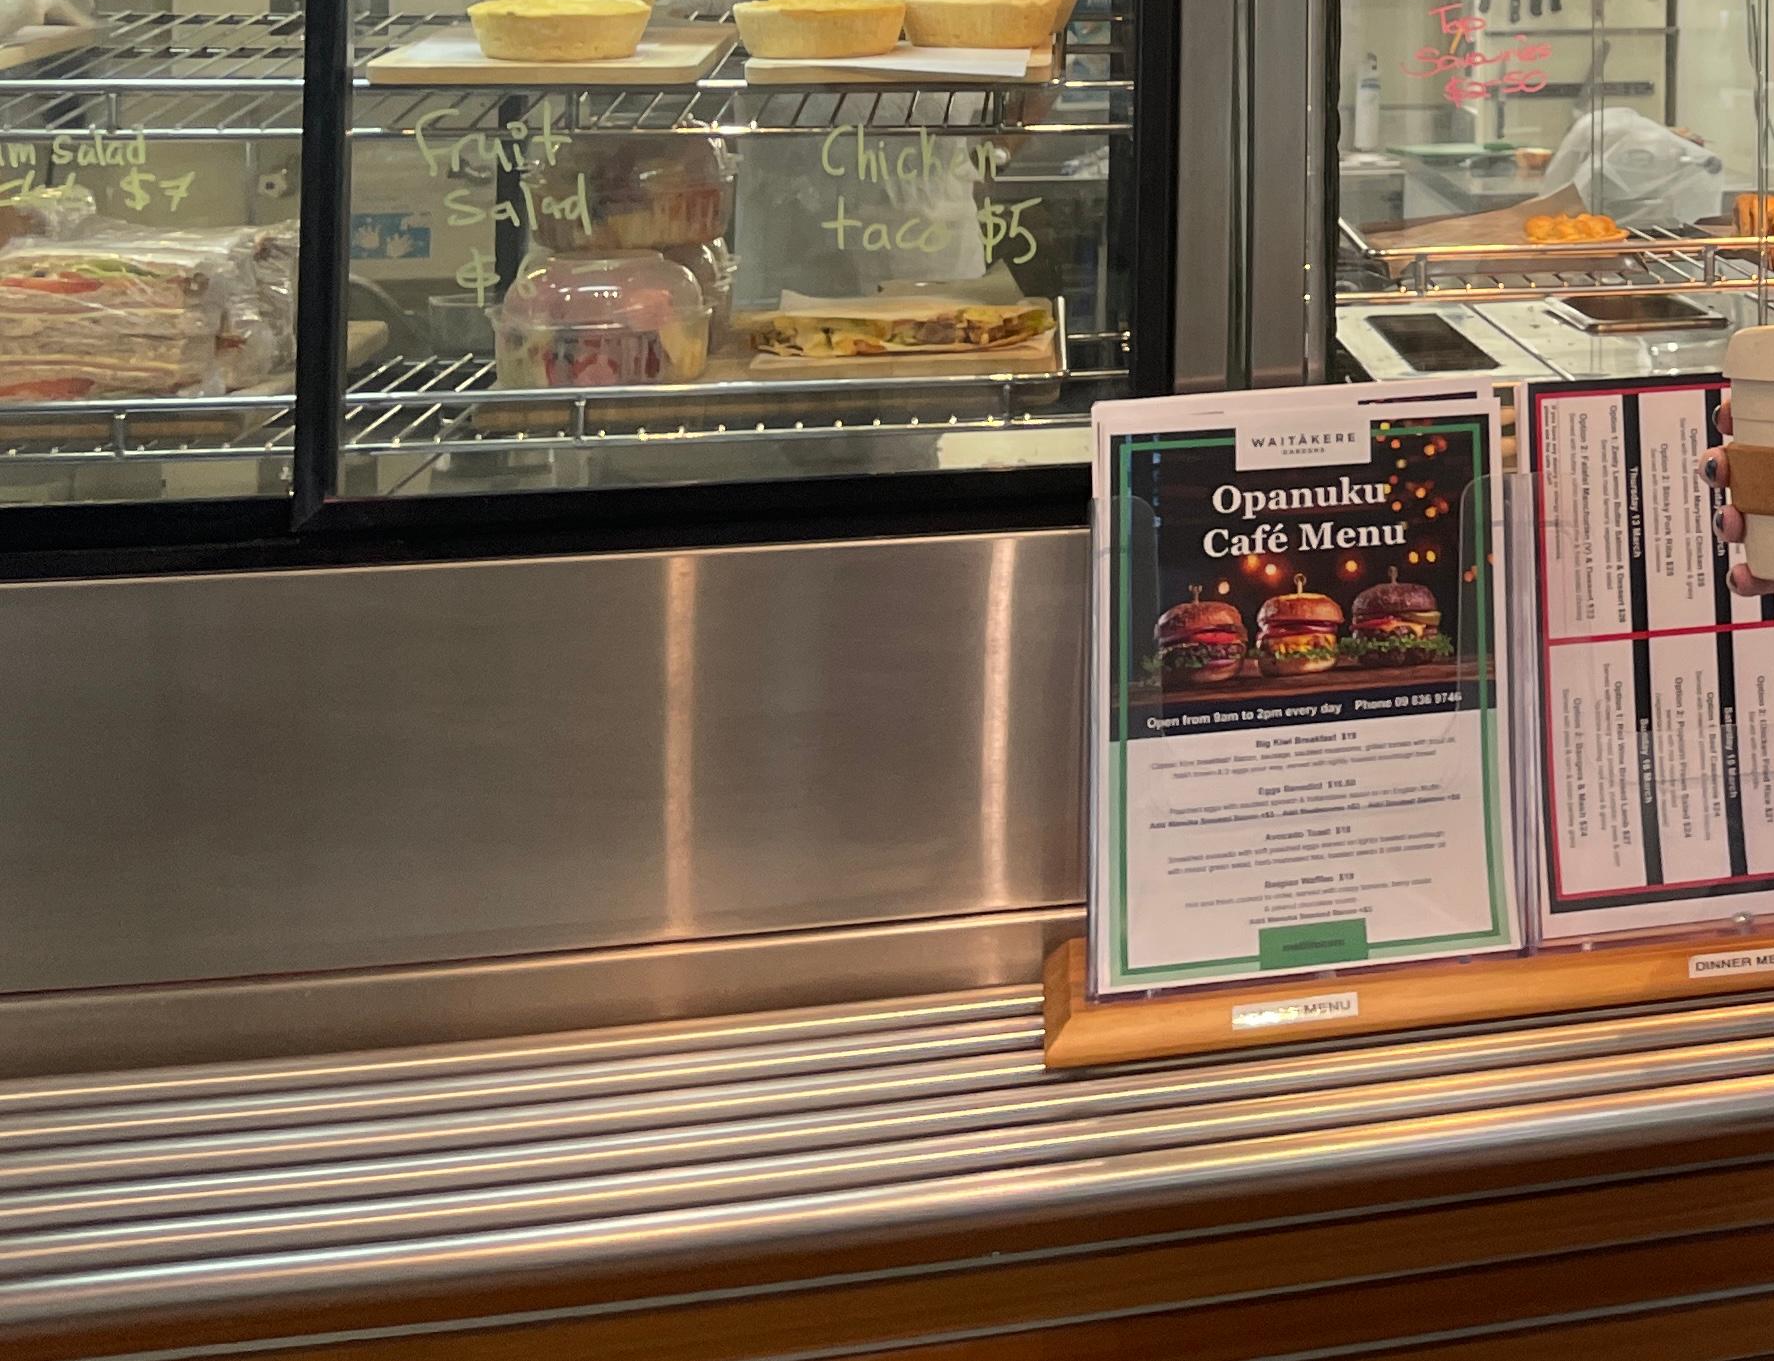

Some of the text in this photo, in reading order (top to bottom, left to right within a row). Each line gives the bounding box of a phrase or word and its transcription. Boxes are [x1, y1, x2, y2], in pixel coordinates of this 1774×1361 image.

[51, 132, 147, 167] Salad
[415, 101, 573, 177] Fruit
[822, 124, 1001, 184] Chicken
[443, 173, 593, 235] Salad
[821, 196, 1042, 265] taco $5
[1212, 476, 1388, 519] Opanuku
[1202, 520, 1407, 559] Café Menu
[1147, 715, 1179, 730] Open
[1183, 714, 1210, 724] from
[1242, 710, 1254, 720] to
[1257, 708, 1282, 720] 2pm
[1285, 703, 1318, 717] every
[1321, 703, 1342, 715] day
[1695, 957, 1752, 971] DINNER
[1303, 1000, 1351, 1014] MENU
